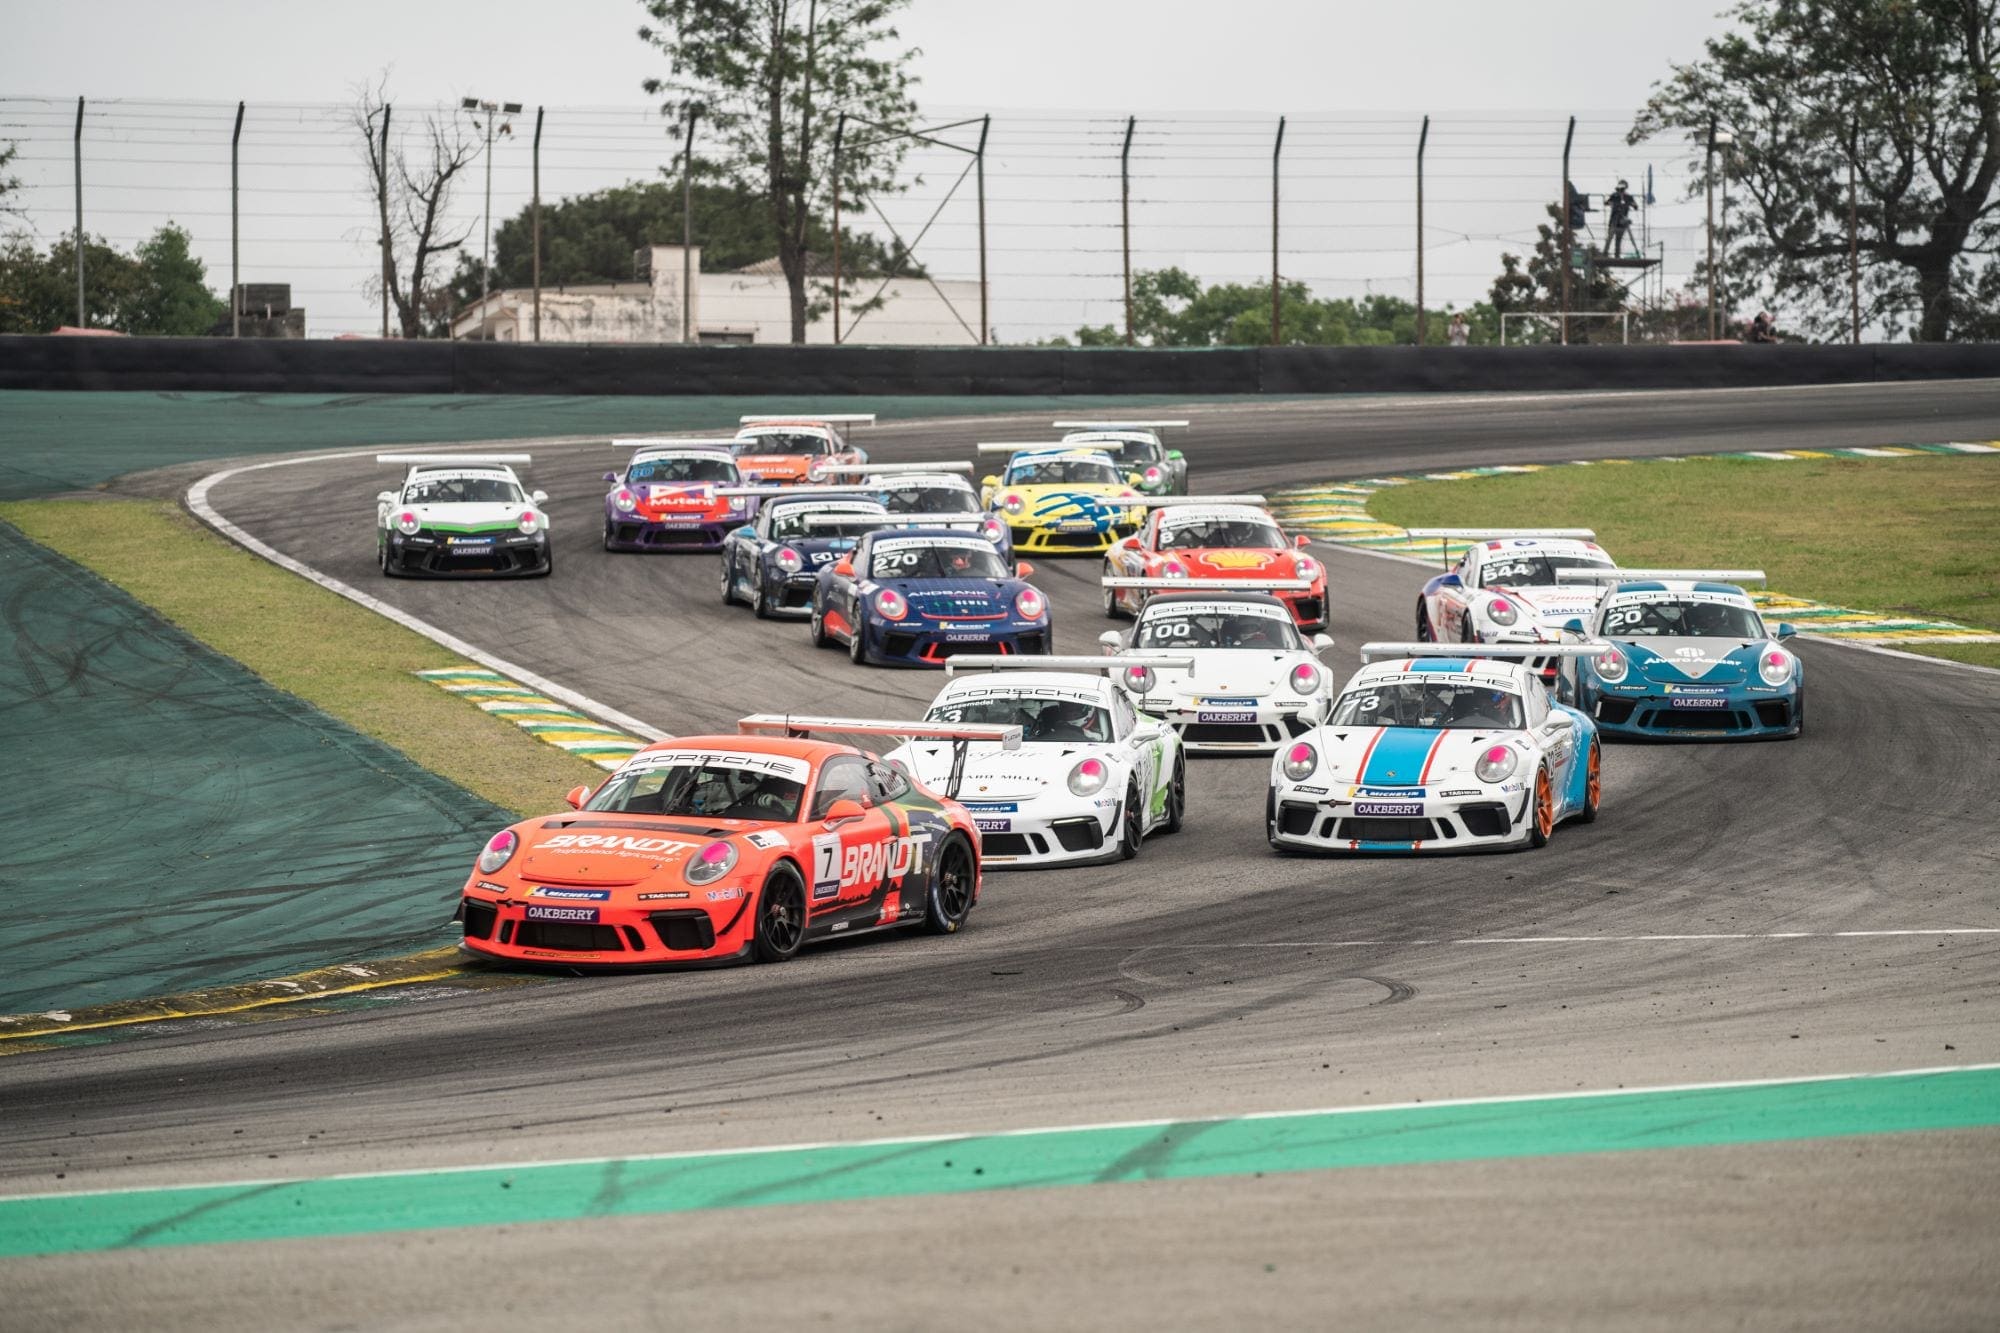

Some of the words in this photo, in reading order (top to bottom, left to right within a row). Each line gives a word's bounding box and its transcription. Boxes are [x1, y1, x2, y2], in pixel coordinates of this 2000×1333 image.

[1160, 531, 1174, 544] 8
[873, 553, 918, 571] 270
[1483, 563, 1529, 581] 544
[1617, 593, 1746, 606] PORSCHE
[1153, 605, 1281, 616] PORSCHE
[1609, 610, 1642, 627] 20
[1140, 623, 1190, 640] 100
[1359, 674, 1514, 689] PORSCHE
[947, 688, 1100, 703] PORSCHE
[1673, 698, 1726, 708] OAKBERRY
[1342, 696, 1380, 716] 73
[1201, 713, 1254, 722] OAKBERRY
[629, 755, 796, 775] PORSCHE
[1358, 804, 1420, 814] OAKBERRY
[974, 820, 1007, 830] ERRY
[532, 835, 702, 855] BRANDT
[550, 848, 613, 856] Professional
[823, 847, 833, 879] 7
[840, 833, 932, 888] BRANDT
[548, 890, 604, 899] MICHELIN
[528, 907, 596, 921] OAKBERRY
